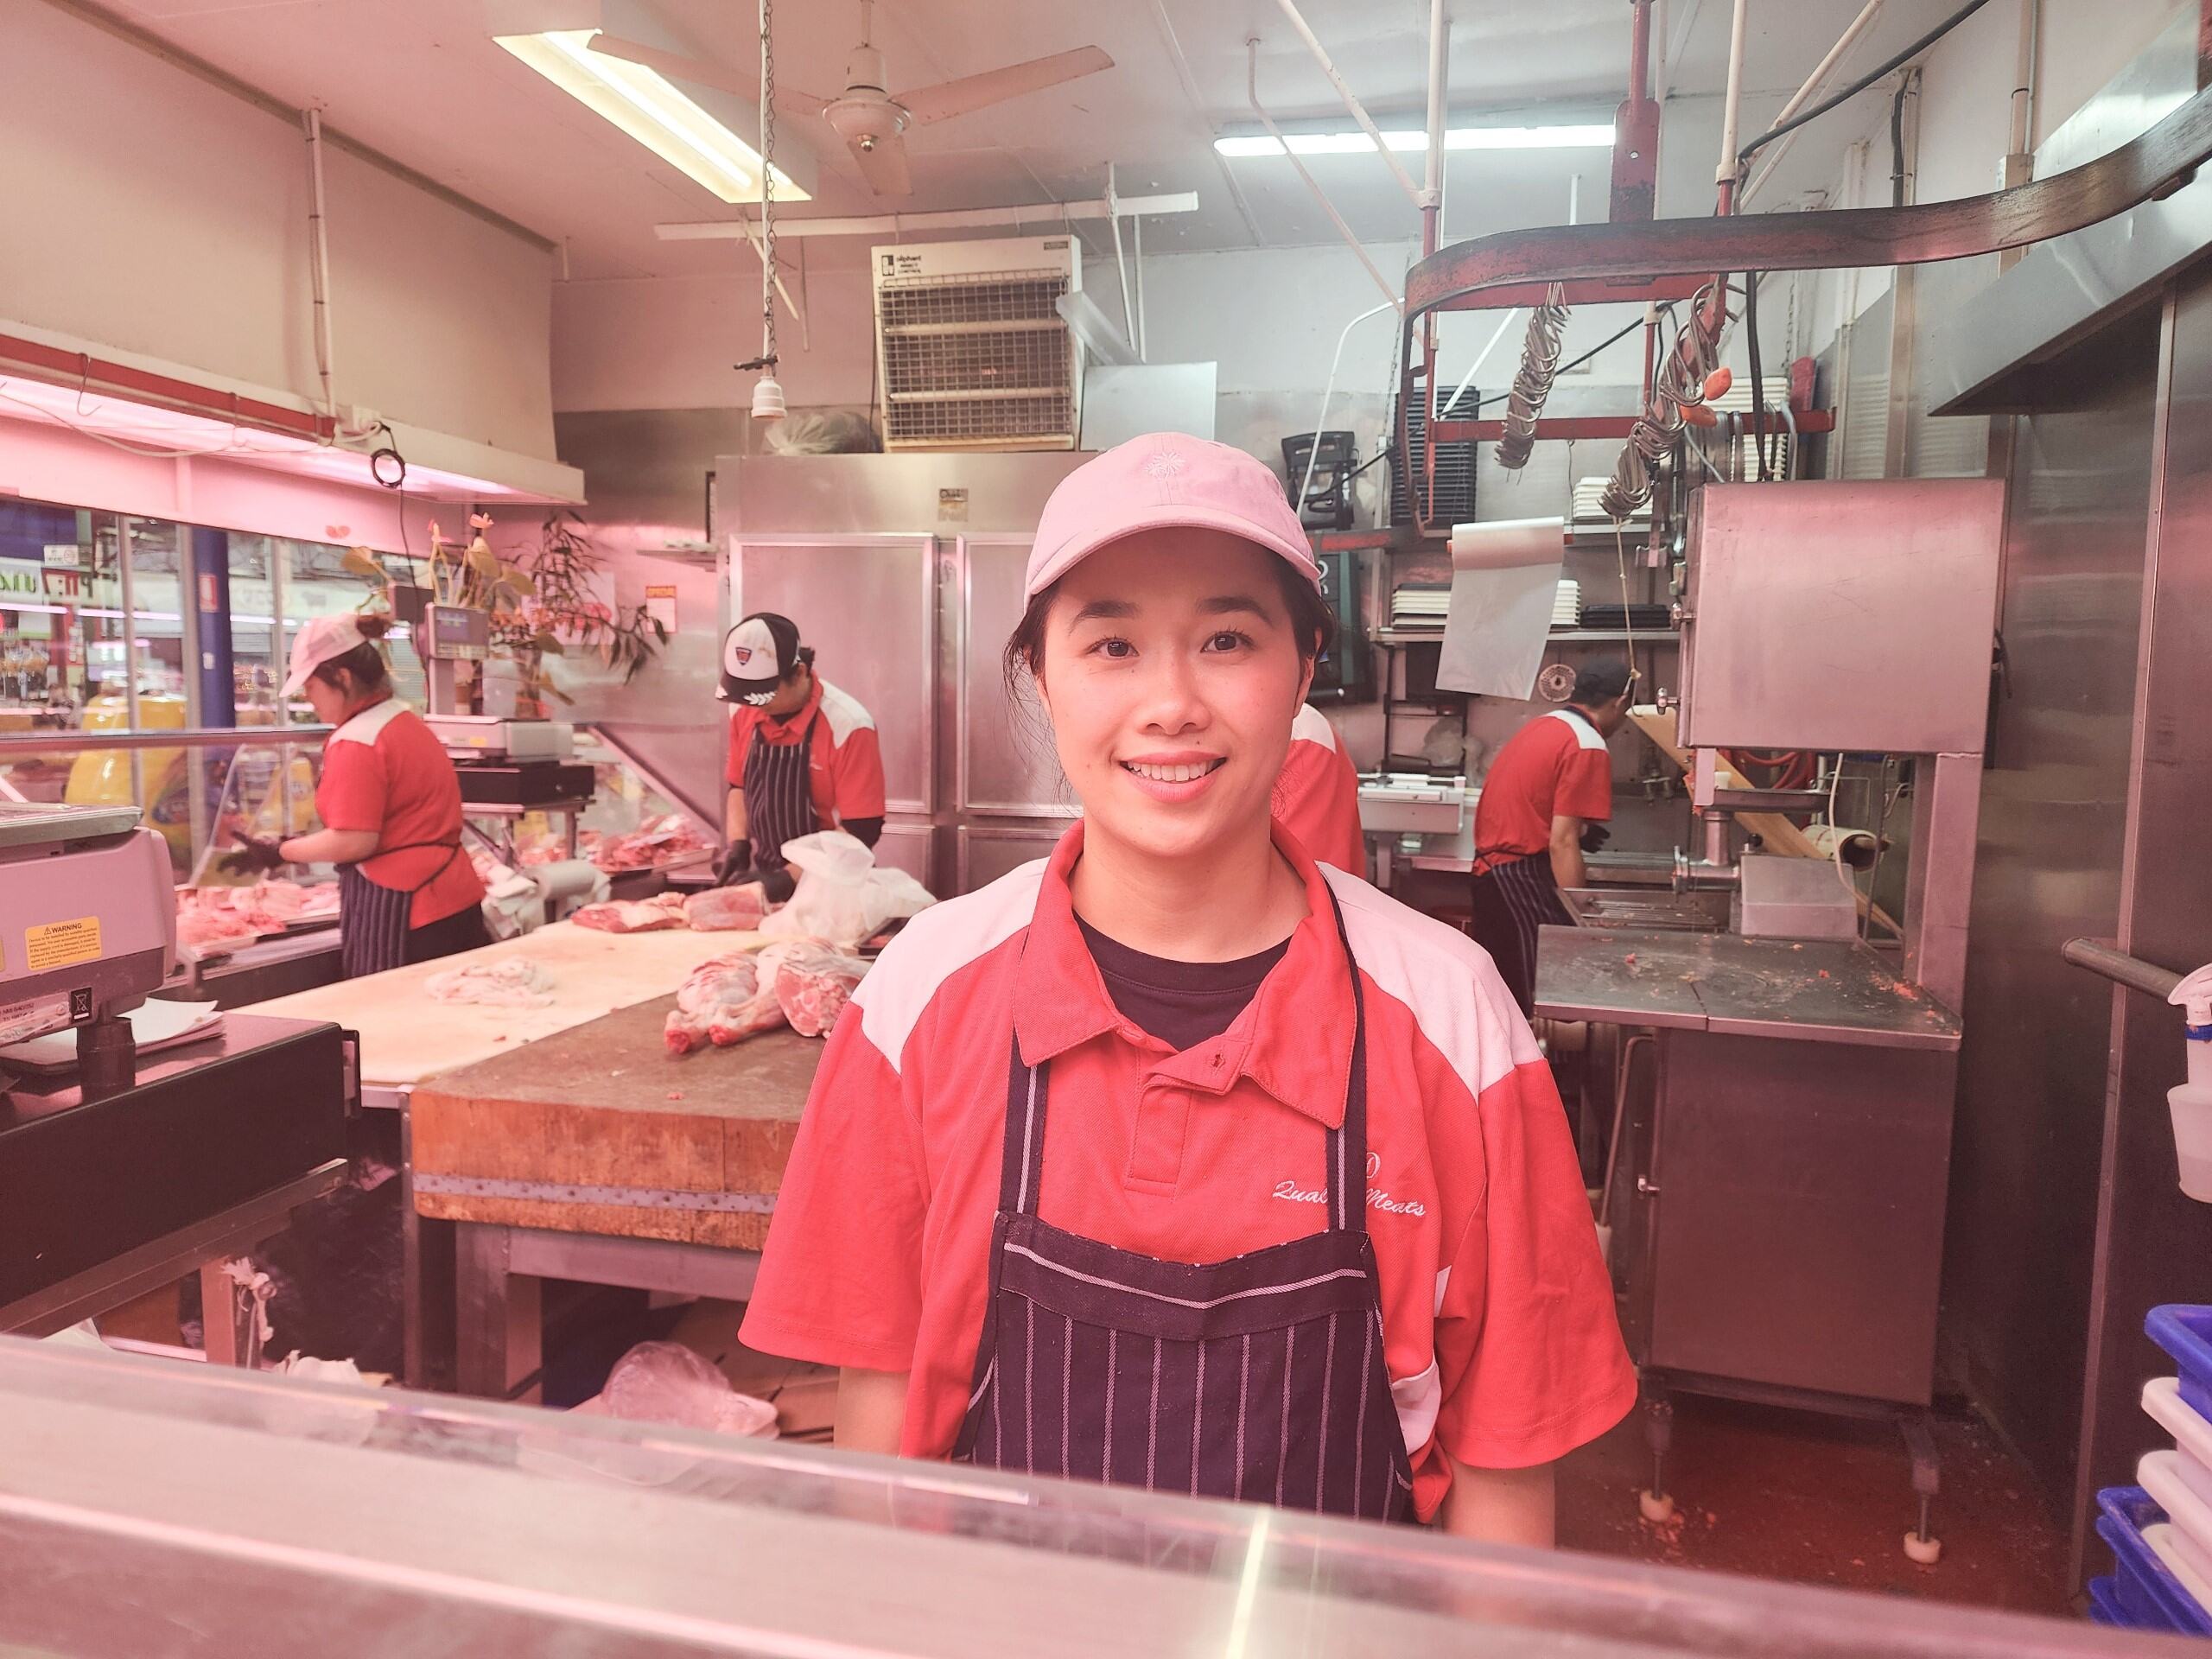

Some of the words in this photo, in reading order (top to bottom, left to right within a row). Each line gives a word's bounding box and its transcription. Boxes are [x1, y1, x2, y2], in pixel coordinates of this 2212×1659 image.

[51, 922, 82, 934] WARNING
[1273, 1180, 1328, 1204] Qual
[1366, 1187, 1426, 1217] Meats
